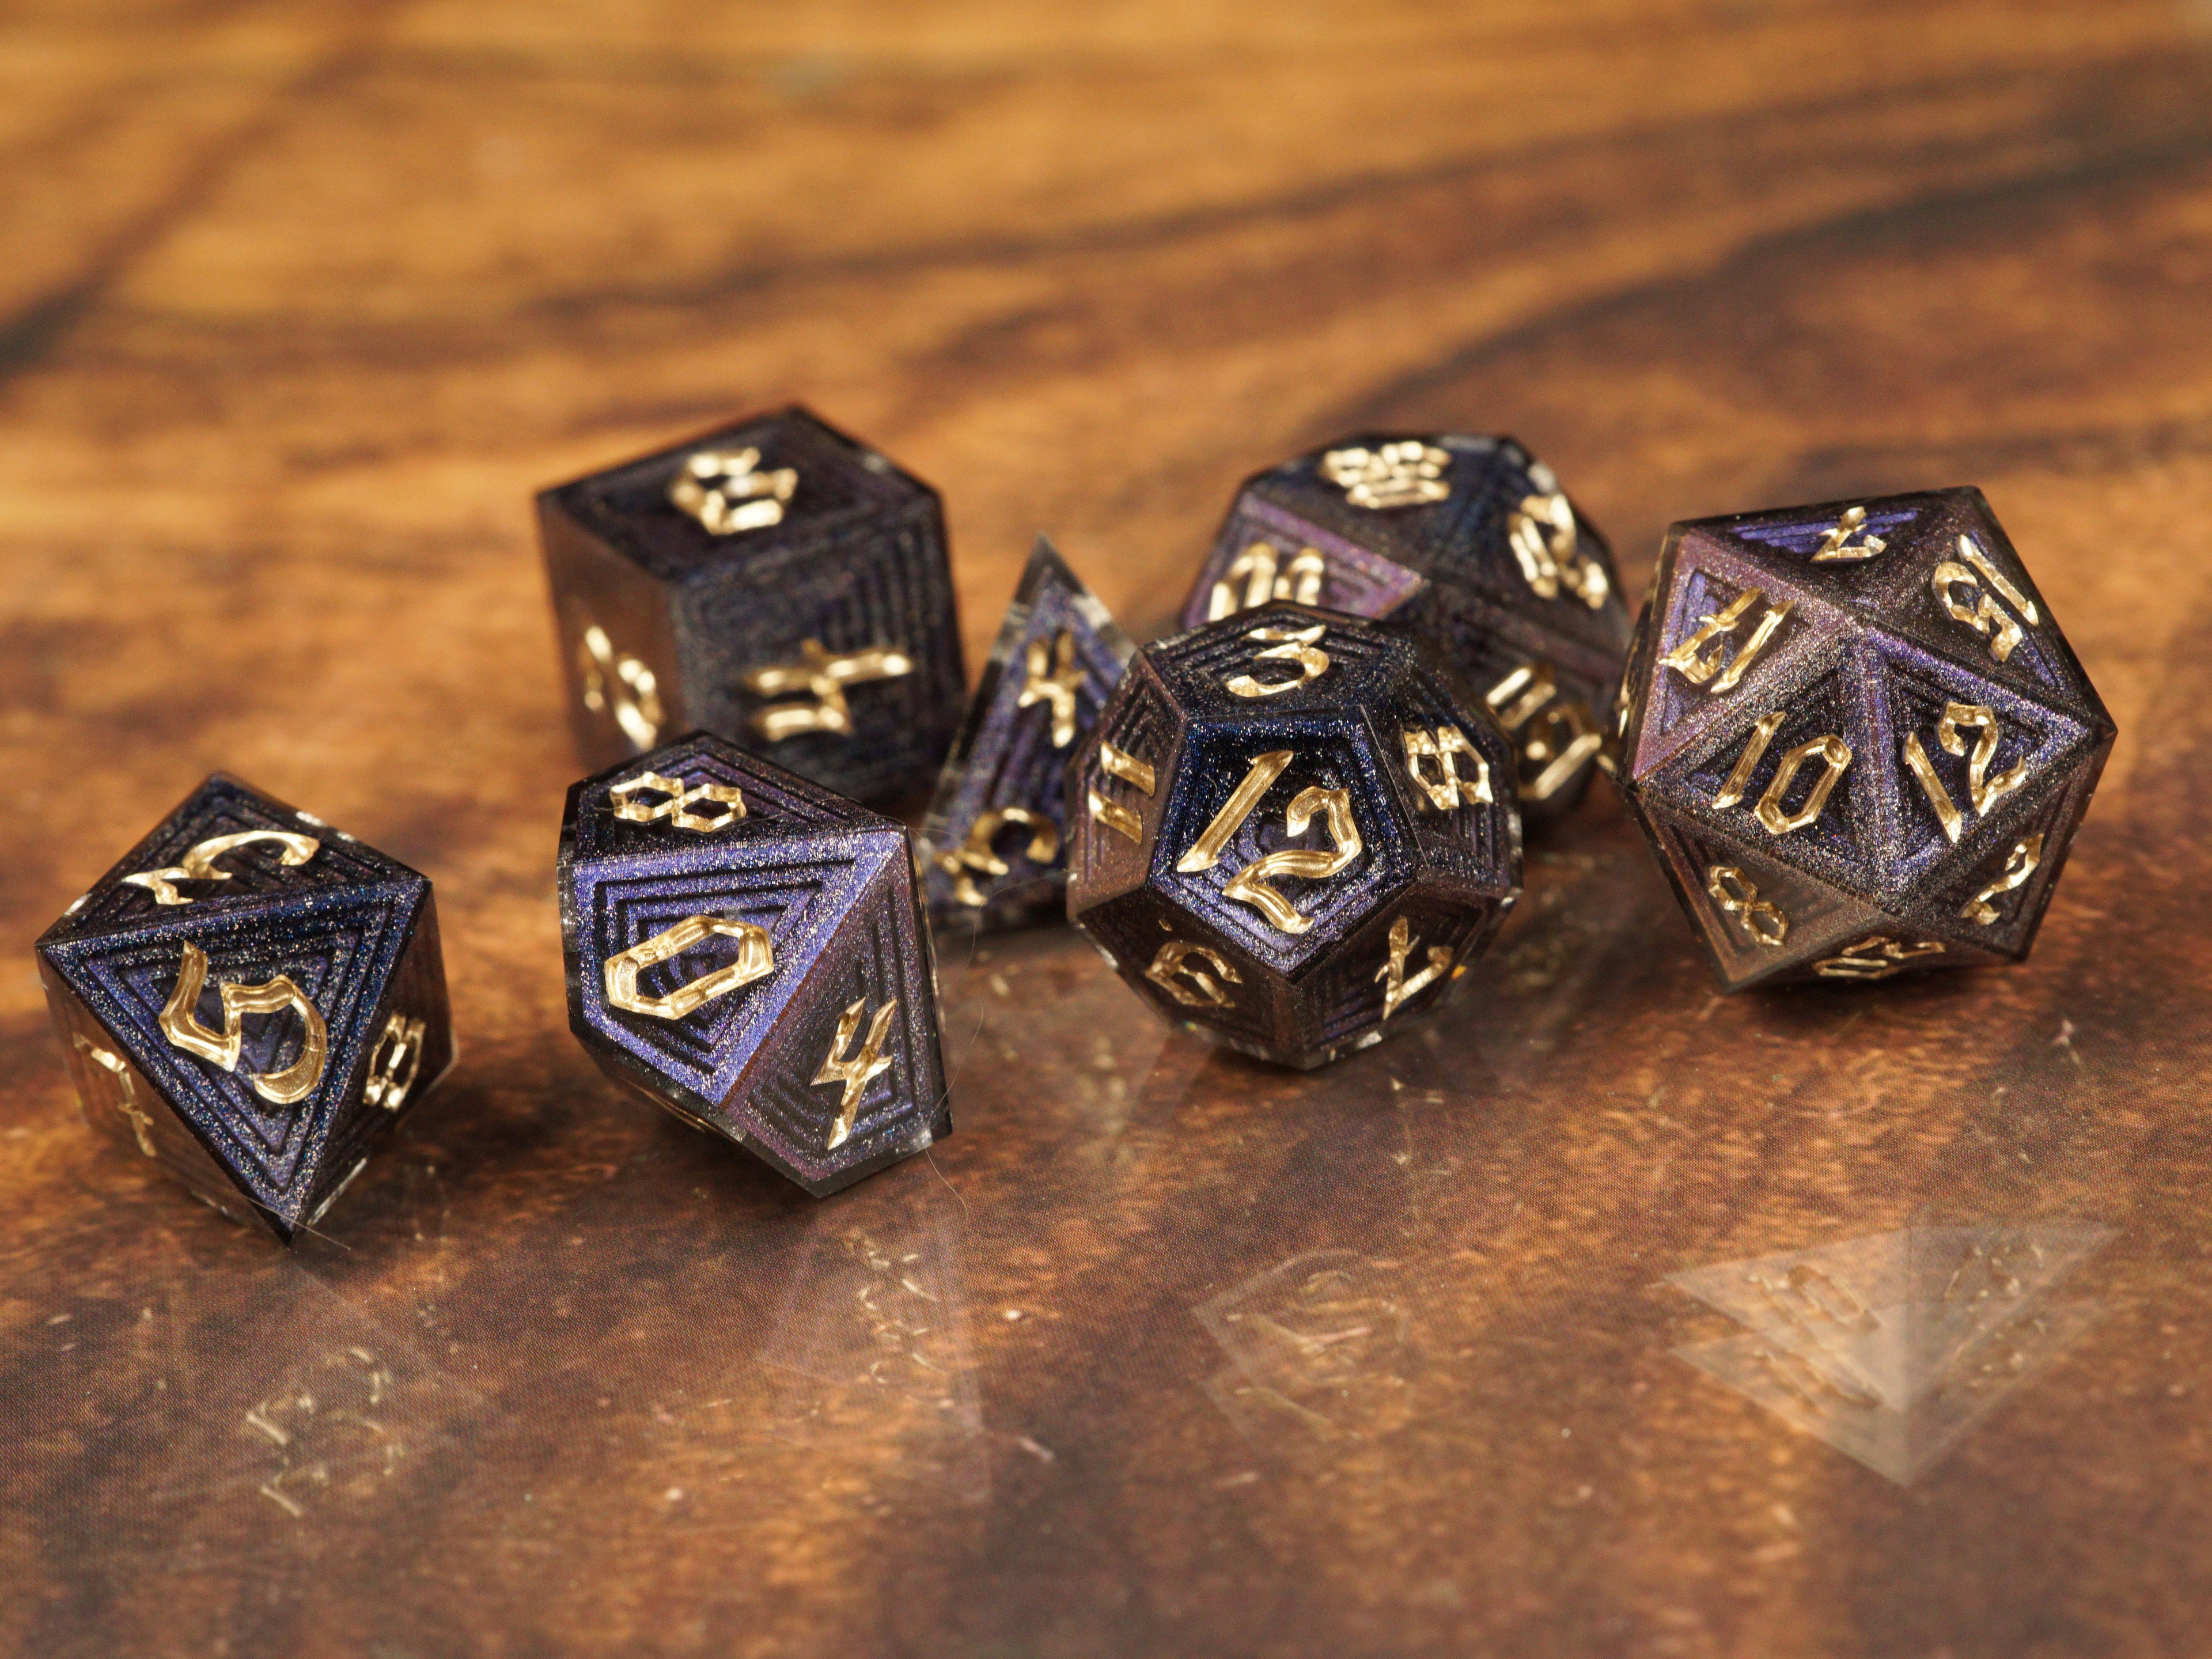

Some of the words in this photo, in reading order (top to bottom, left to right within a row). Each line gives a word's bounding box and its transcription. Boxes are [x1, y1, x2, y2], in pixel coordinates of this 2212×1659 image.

[1018, 631, 1087, 748] 4
[1226, 624, 1330, 698] 3
[609, 771, 747, 833] 8
[1403, 725, 1494, 810] 8
[1711, 710, 1852, 835] 10
[1904, 700, 2025, 843] 12
[1176, 751, 1362, 934] 12
[1709, 865, 1787, 945] 8
[159, 939, 327, 1104] 5
[604, 914, 775, 1020] 0
[362, 1014, 426, 1112] 8
[810, 997, 898, 1150] 4
